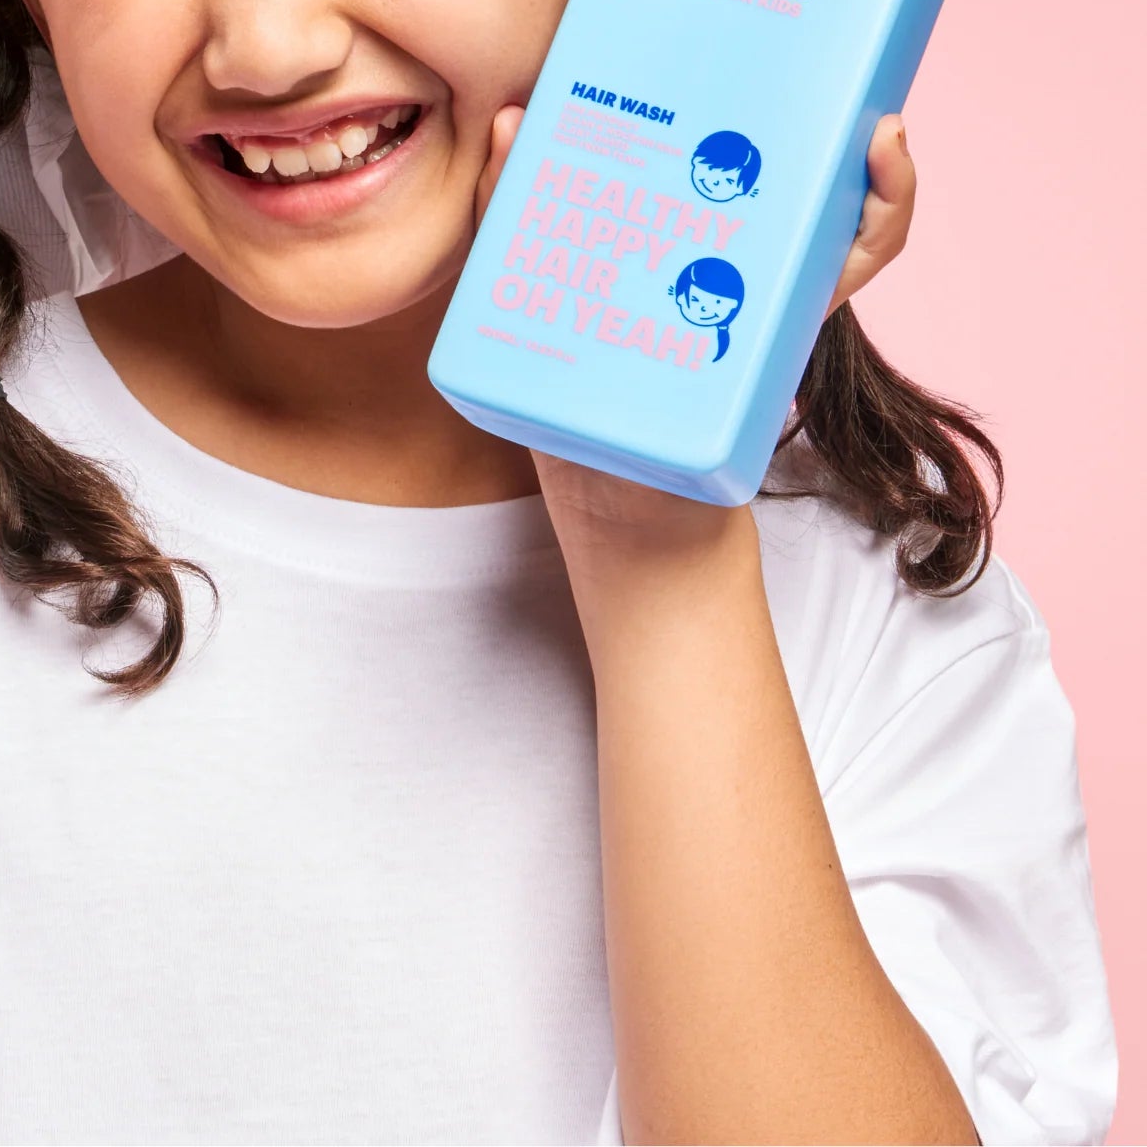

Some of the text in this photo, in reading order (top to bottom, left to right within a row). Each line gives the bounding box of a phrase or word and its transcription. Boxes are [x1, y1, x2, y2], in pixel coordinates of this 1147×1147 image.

[571, 81, 617, 108] HAIR
[619, 95, 675, 125] WASH
[518, 195, 677, 273] HAPPY
[532, 158, 745, 252] HEALTHY
[504, 233, 620, 300] HAIR
[491, 273, 565, 324] OH
[572, 295, 711, 372] YEAH!
